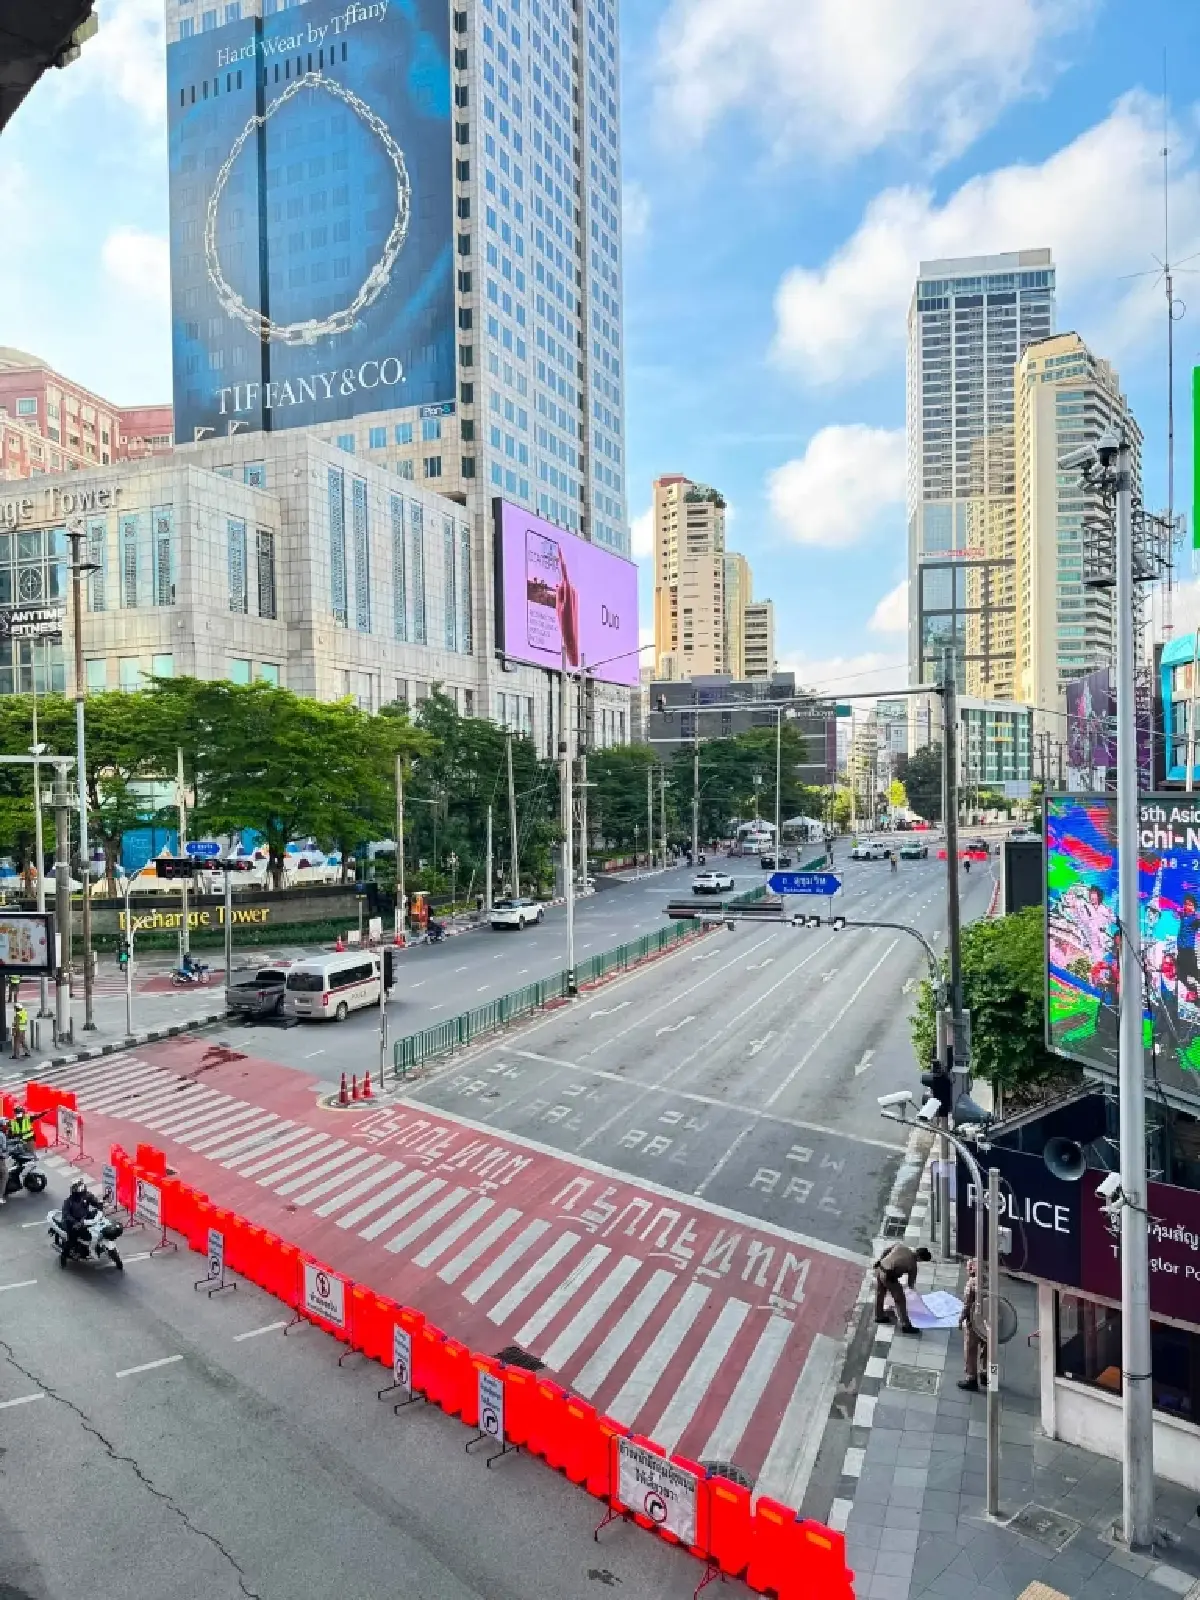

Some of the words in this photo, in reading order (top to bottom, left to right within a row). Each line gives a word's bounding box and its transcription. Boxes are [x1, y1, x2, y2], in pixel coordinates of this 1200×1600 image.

[307, 22, 329, 47] by
[331, 0, 388, 34] Tiffany
[0, 499, 33, 531] ge
[44, 486, 122, 517] Tower
[118, 911, 212, 932] Exchange
[215, 905, 270, 924] Tower
[967, 1183, 1071, 1234] POLICE
